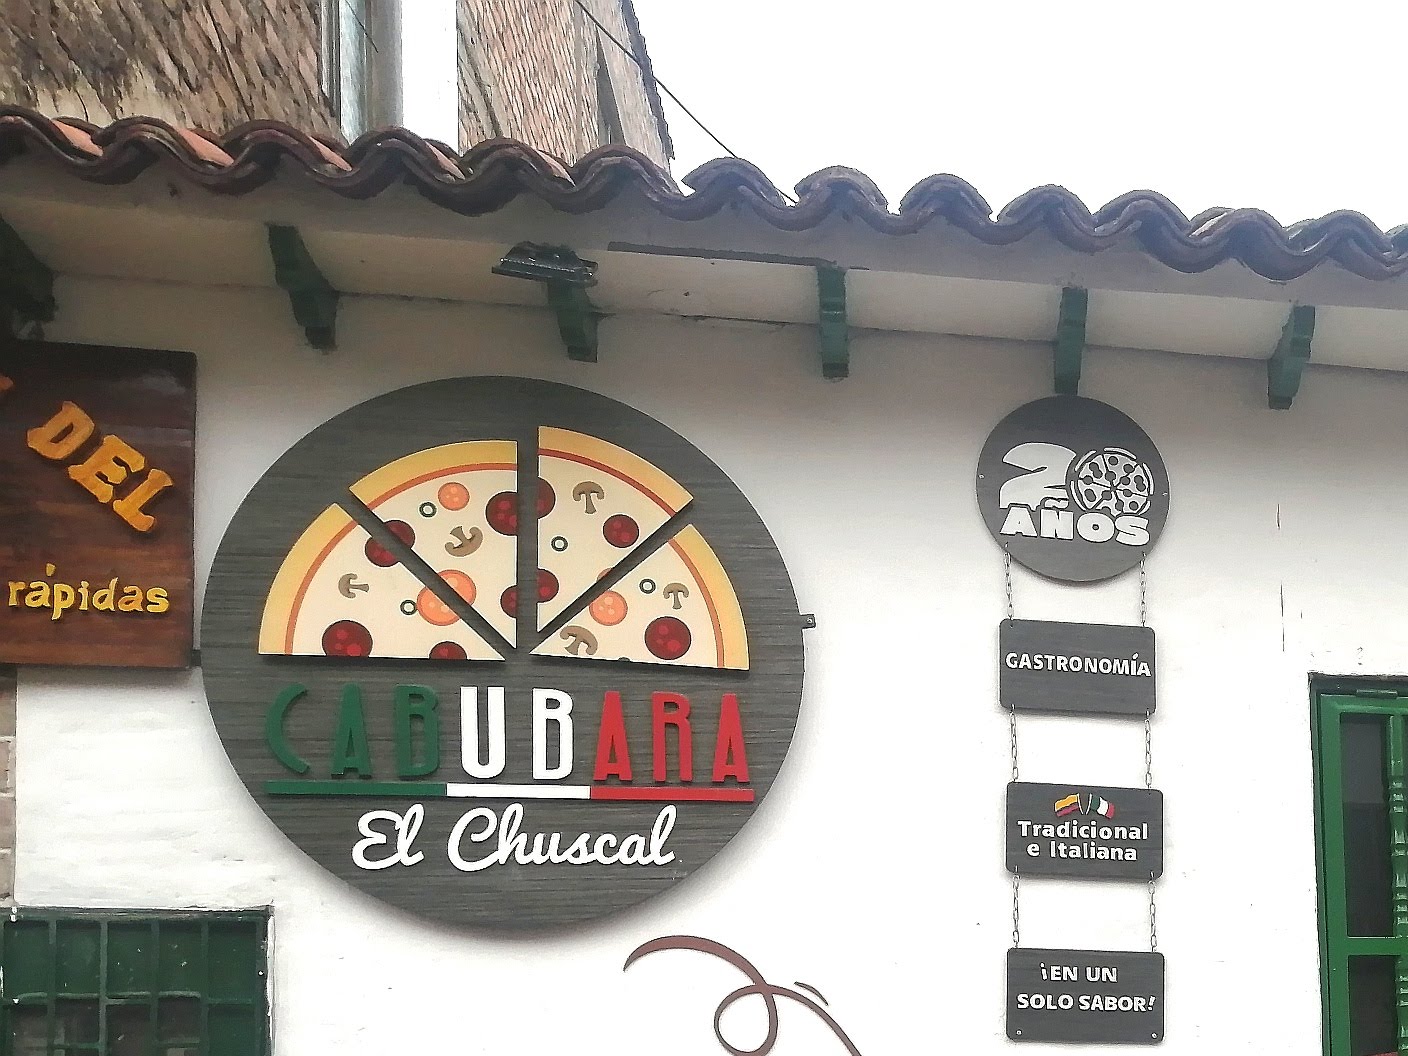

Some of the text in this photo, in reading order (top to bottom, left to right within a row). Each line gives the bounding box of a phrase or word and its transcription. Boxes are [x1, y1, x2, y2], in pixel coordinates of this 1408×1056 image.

[26, 400, 174, 532] DEL
[999, 497, 1151, 547] AÑOS
[7, 562, 170, 621] rápidas
[1005, 652, 1152, 678] GASTRONOMÍA
[264, 683, 750, 783] CABUBARA
[351, 802, 677, 873] El Chuscal
[1017, 819, 1149, 840] Tradicional
[1026, 840, 1138, 861] e Italiana
[1040, 963, 1118, 983] ¡EN UN
[1017, 993, 1156, 1012] SOLO SABOR!
